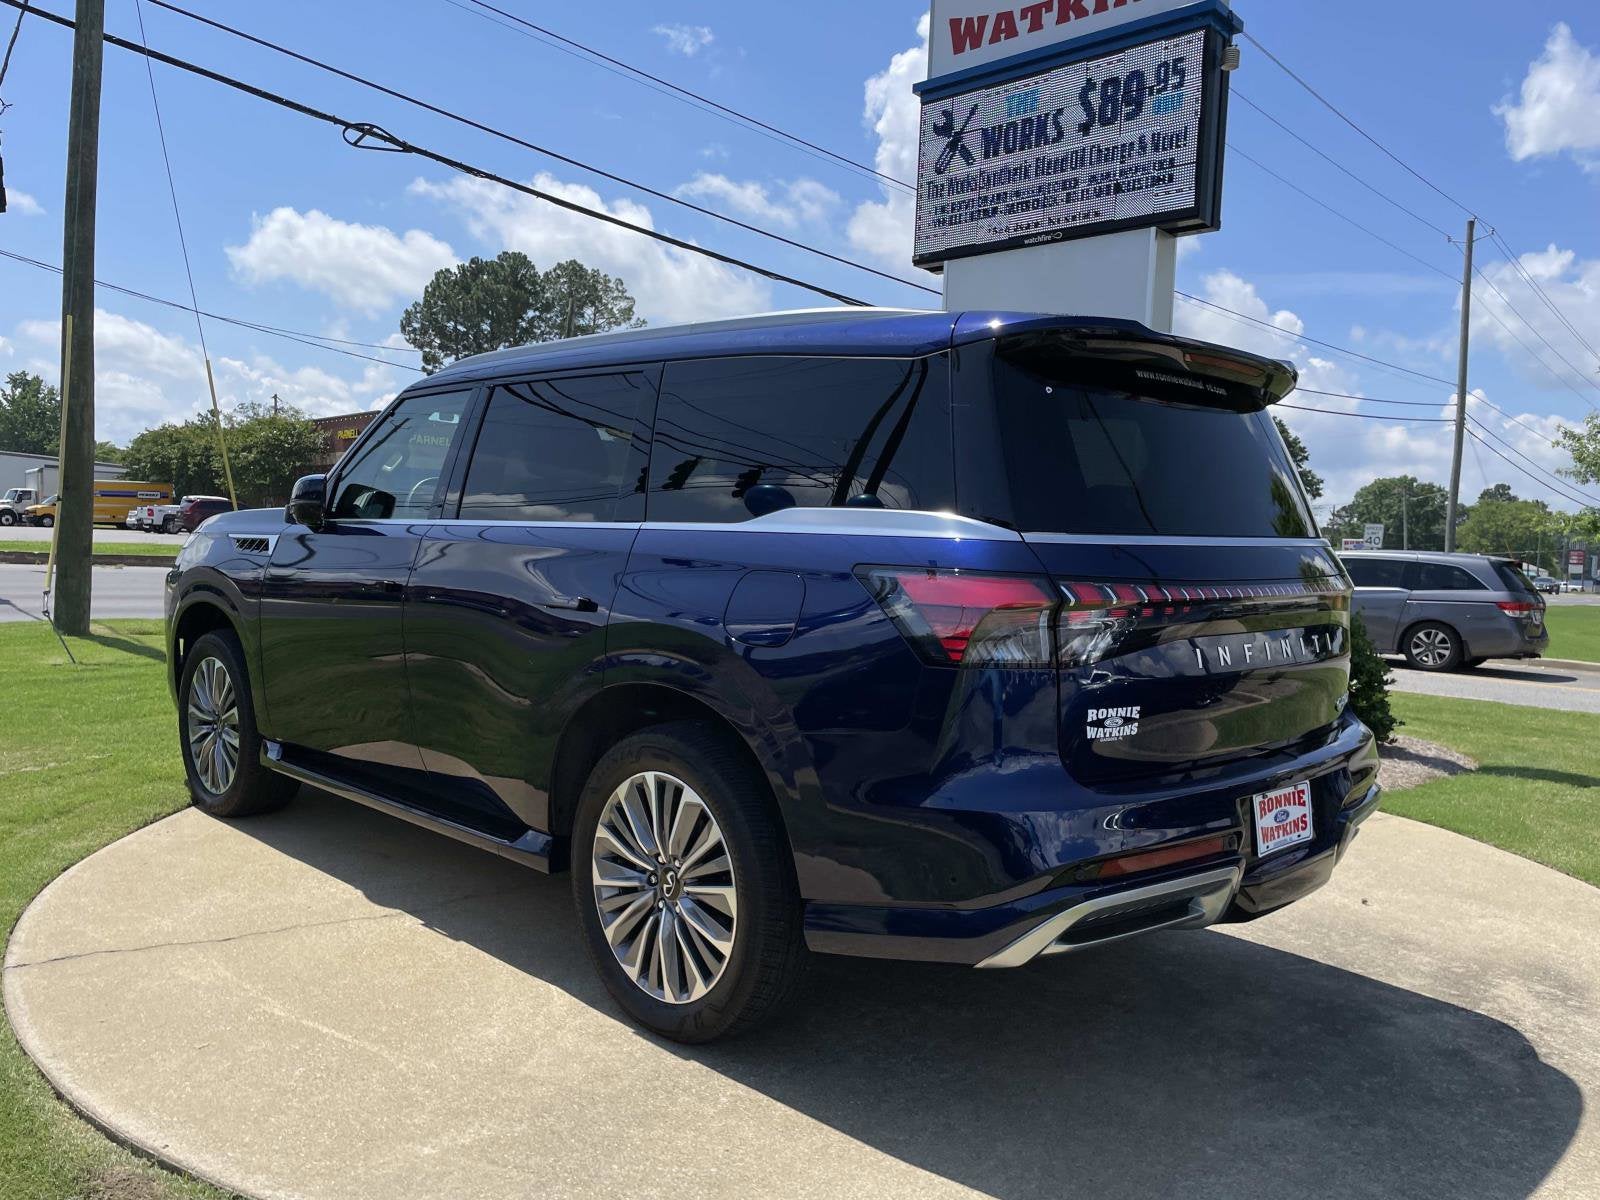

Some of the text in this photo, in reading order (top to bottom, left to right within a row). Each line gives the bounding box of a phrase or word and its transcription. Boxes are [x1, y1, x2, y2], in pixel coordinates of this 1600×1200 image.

[981, 108, 1065, 159] WORKS
[926, 178, 944, 200] The
[1024, 233, 1052, 245] watchfire
[1365, 536, 1381, 546] 40
[1195, 633, 1332, 670] INFINITI
[1087, 705, 1141, 722] RONNIE
[1086, 722, 1139, 739] WATKINS
[1259, 789, 1306, 820] RONNIE
[1261, 813, 1308, 845] WATKINS
